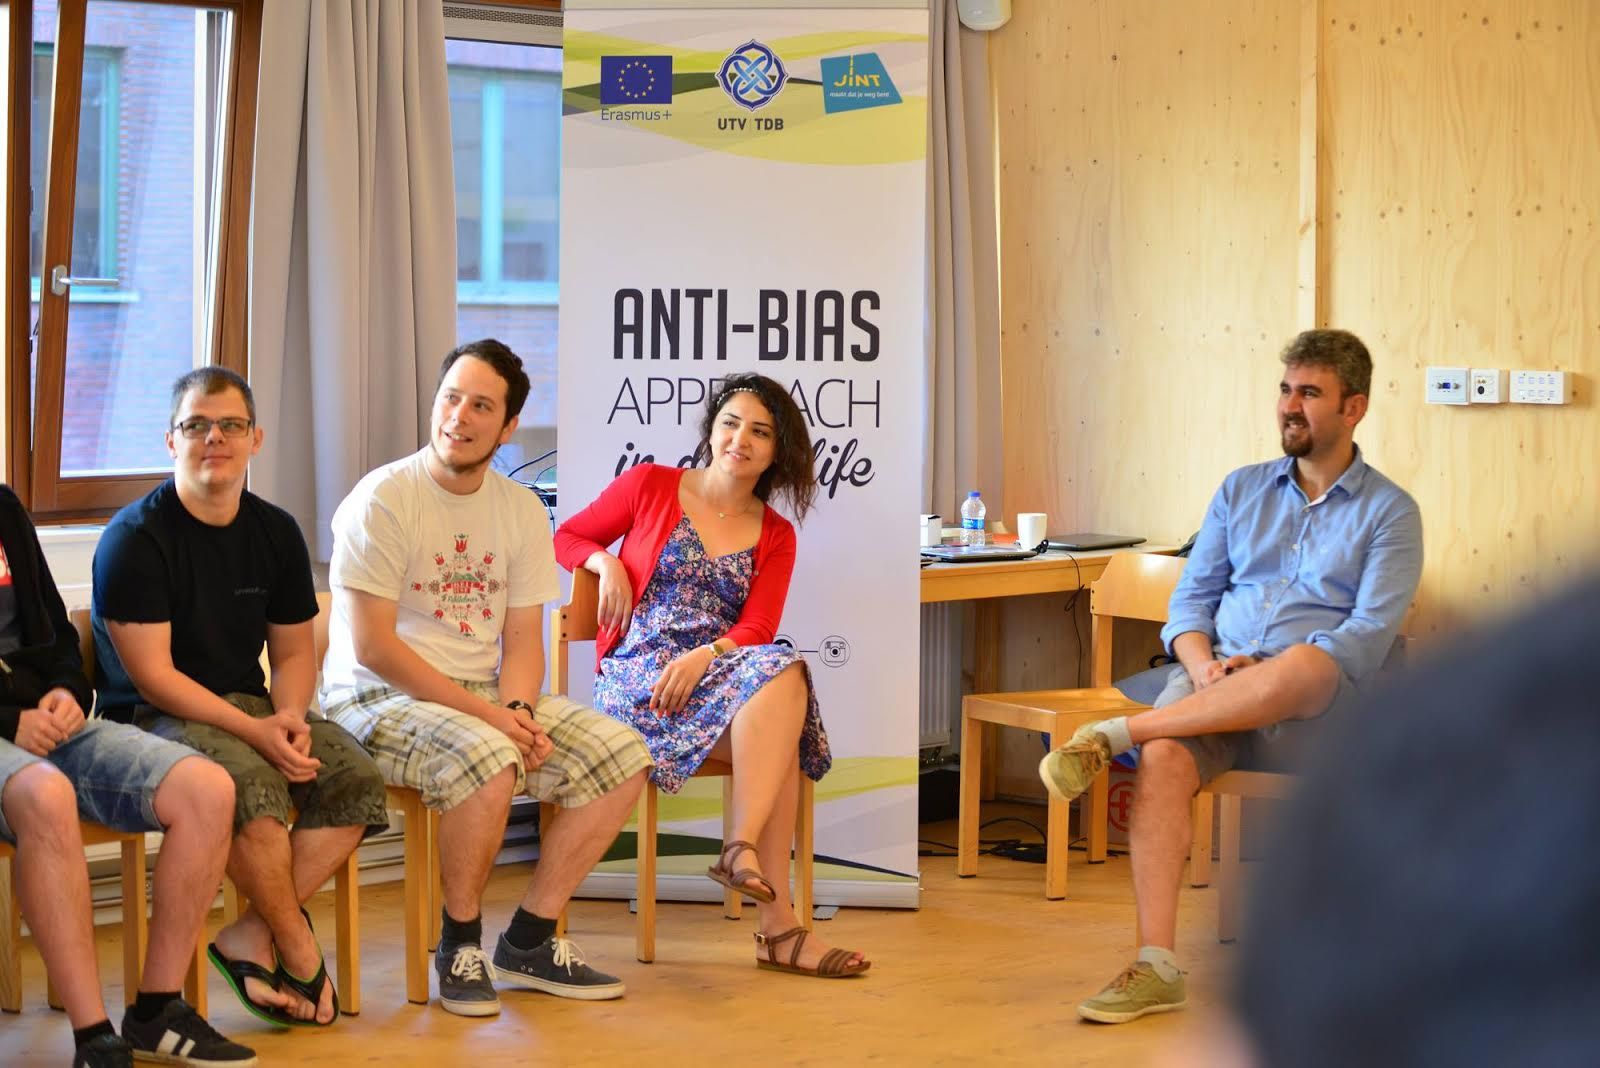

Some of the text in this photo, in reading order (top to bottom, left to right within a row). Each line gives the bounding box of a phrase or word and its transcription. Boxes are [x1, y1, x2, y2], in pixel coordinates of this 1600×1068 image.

[601, 108, 673, 121] Erasmus+
[717, 118, 784, 131] UTV TDB
[613, 288, 881, 362] ANTI-BIAS
[607, 376, 881, 428] APPACH
